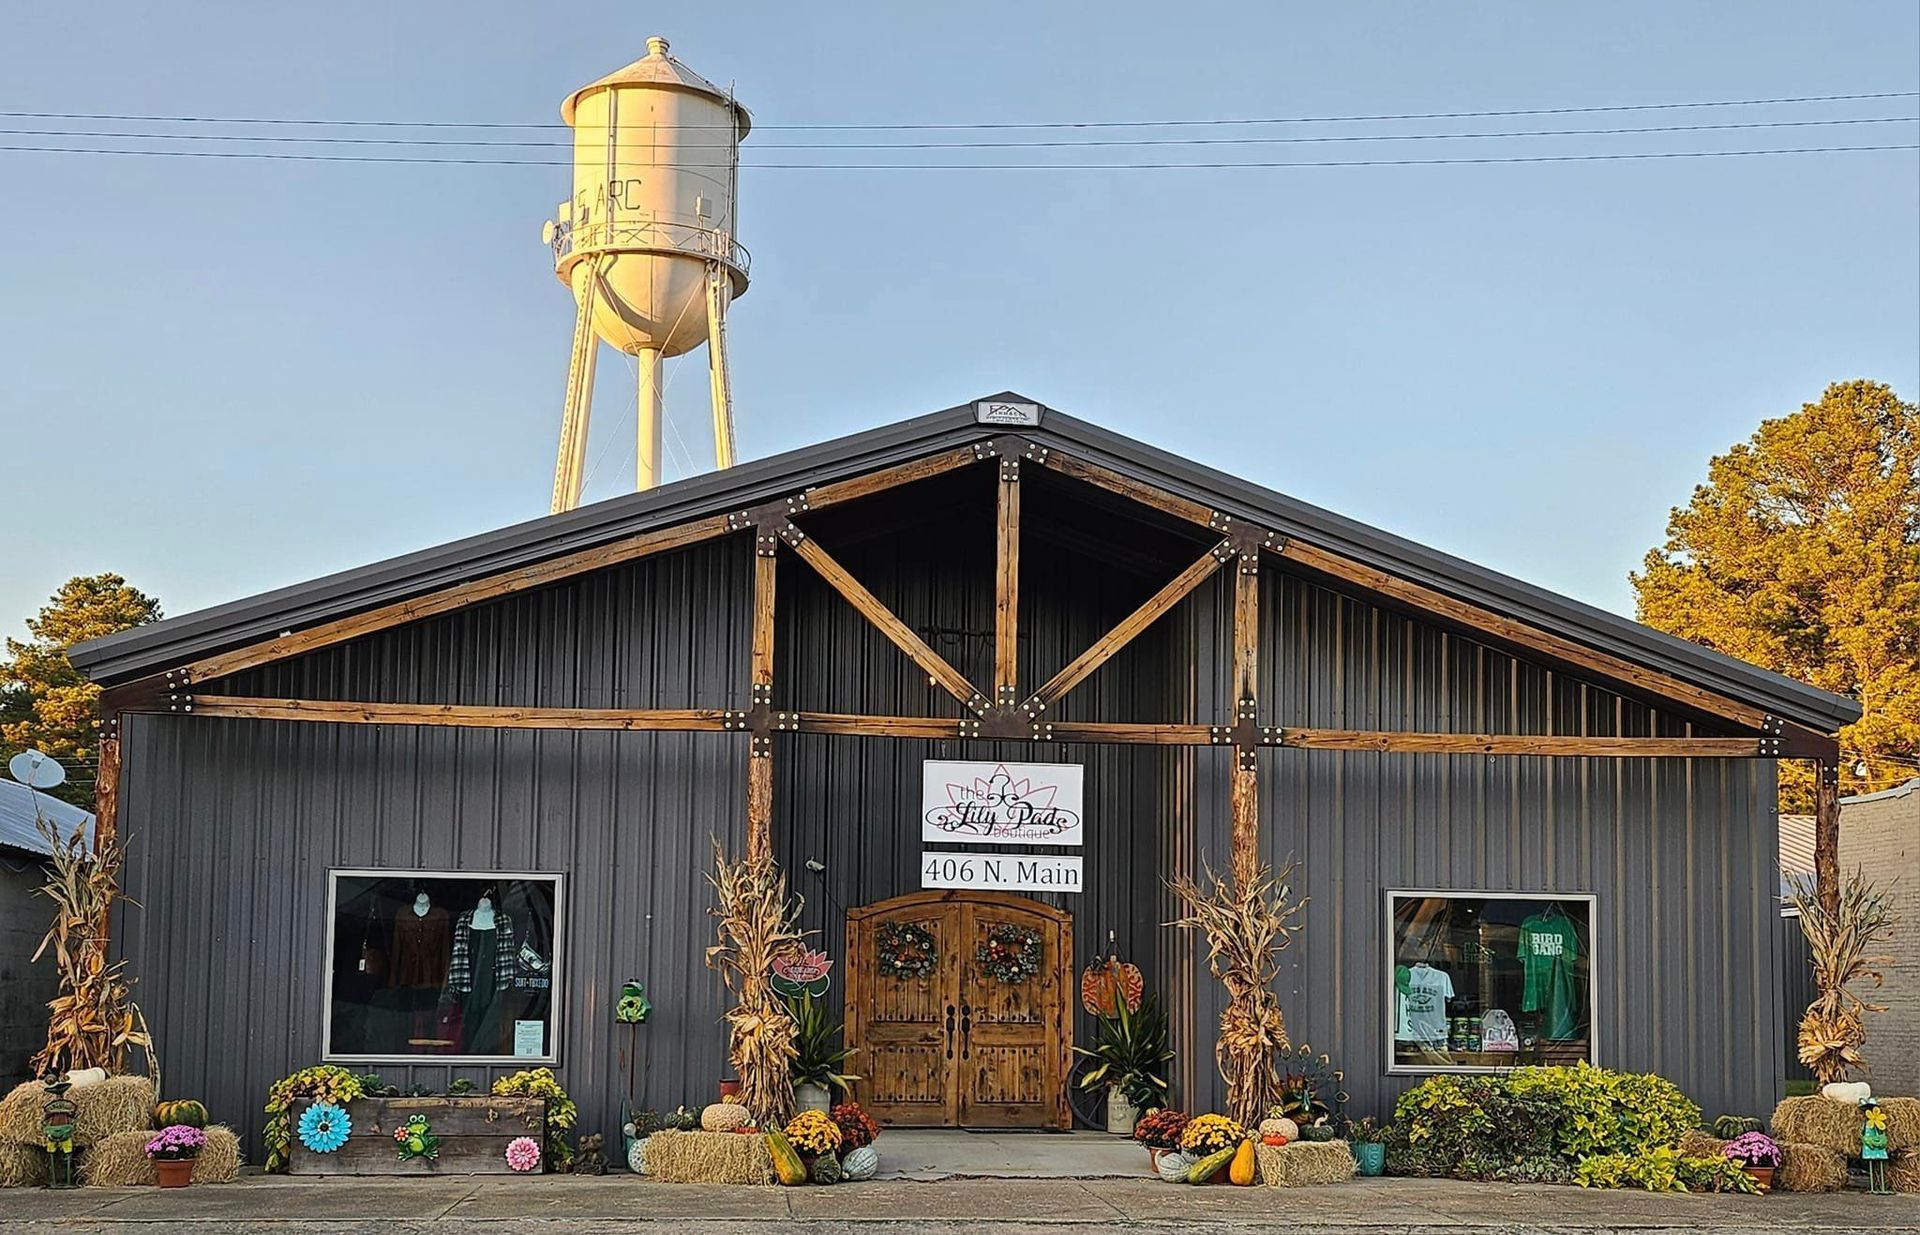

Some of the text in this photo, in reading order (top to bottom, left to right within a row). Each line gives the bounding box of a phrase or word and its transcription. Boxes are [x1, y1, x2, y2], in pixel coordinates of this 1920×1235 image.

[595, 179, 642, 215] ARC
[960, 786, 984, 800] the
[955, 801, 997, 836] Lily
[993, 828, 1051, 841] boutique
[925, 859, 1079, 885] 406 N. Main
[1531, 933, 1563, 945] BIRD
[1532, 943, 1563, 956] GANG
